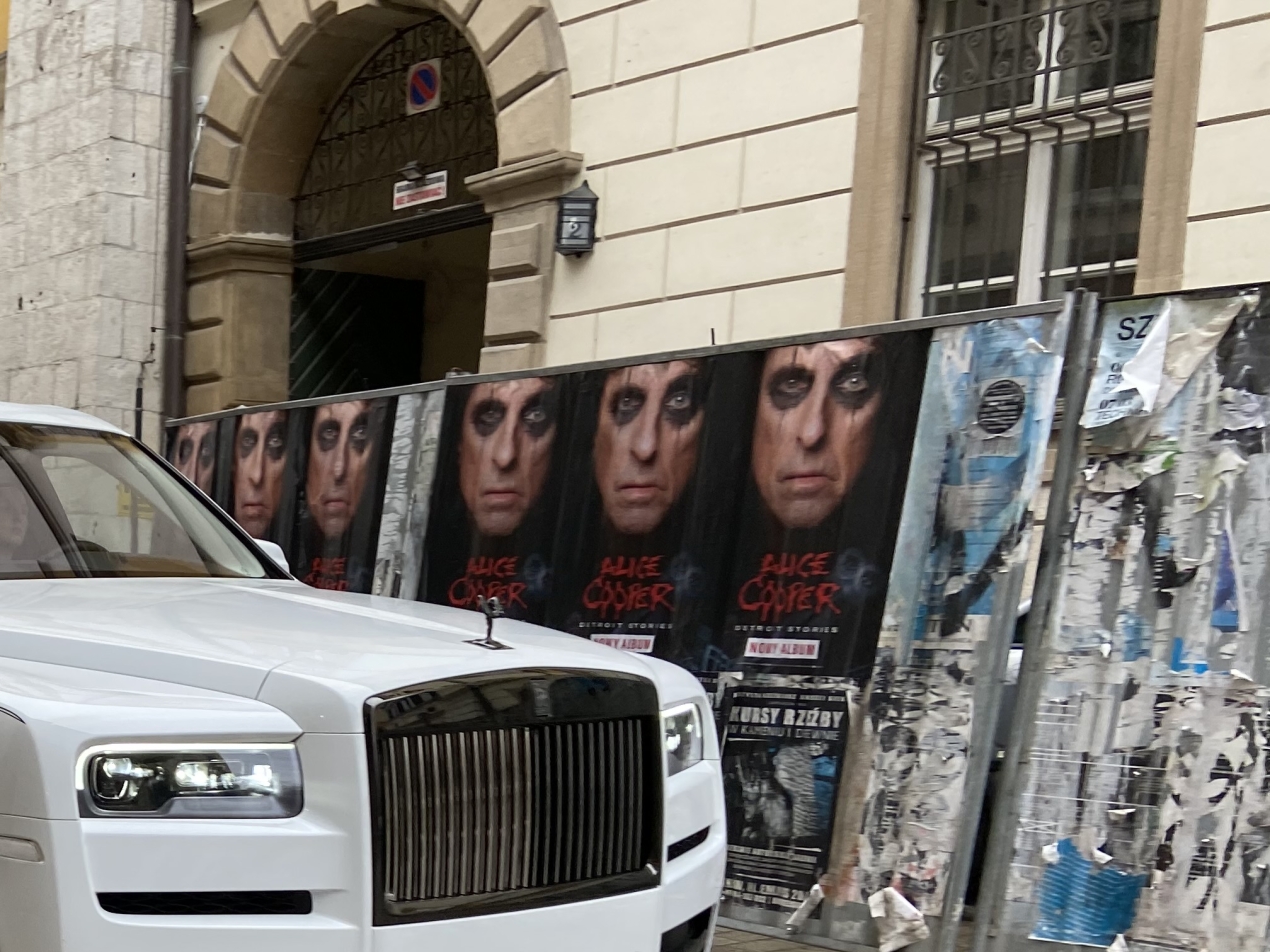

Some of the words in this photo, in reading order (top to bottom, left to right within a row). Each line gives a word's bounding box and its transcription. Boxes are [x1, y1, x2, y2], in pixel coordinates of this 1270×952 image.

[465, 556, 519, 578] ALICE
[600, 555, 664, 578] ALICE
[760, 552, 833, 577] ALICE
[582, 576, 675, 619] COOPER
[737, 574, 841, 622] COOPER
[627, 622, 673, 630] STORIES
[749, 642, 777, 654] NOWY
[780, 643, 815, 656] ALBUM
[729, 705, 781, 724] KURSY
